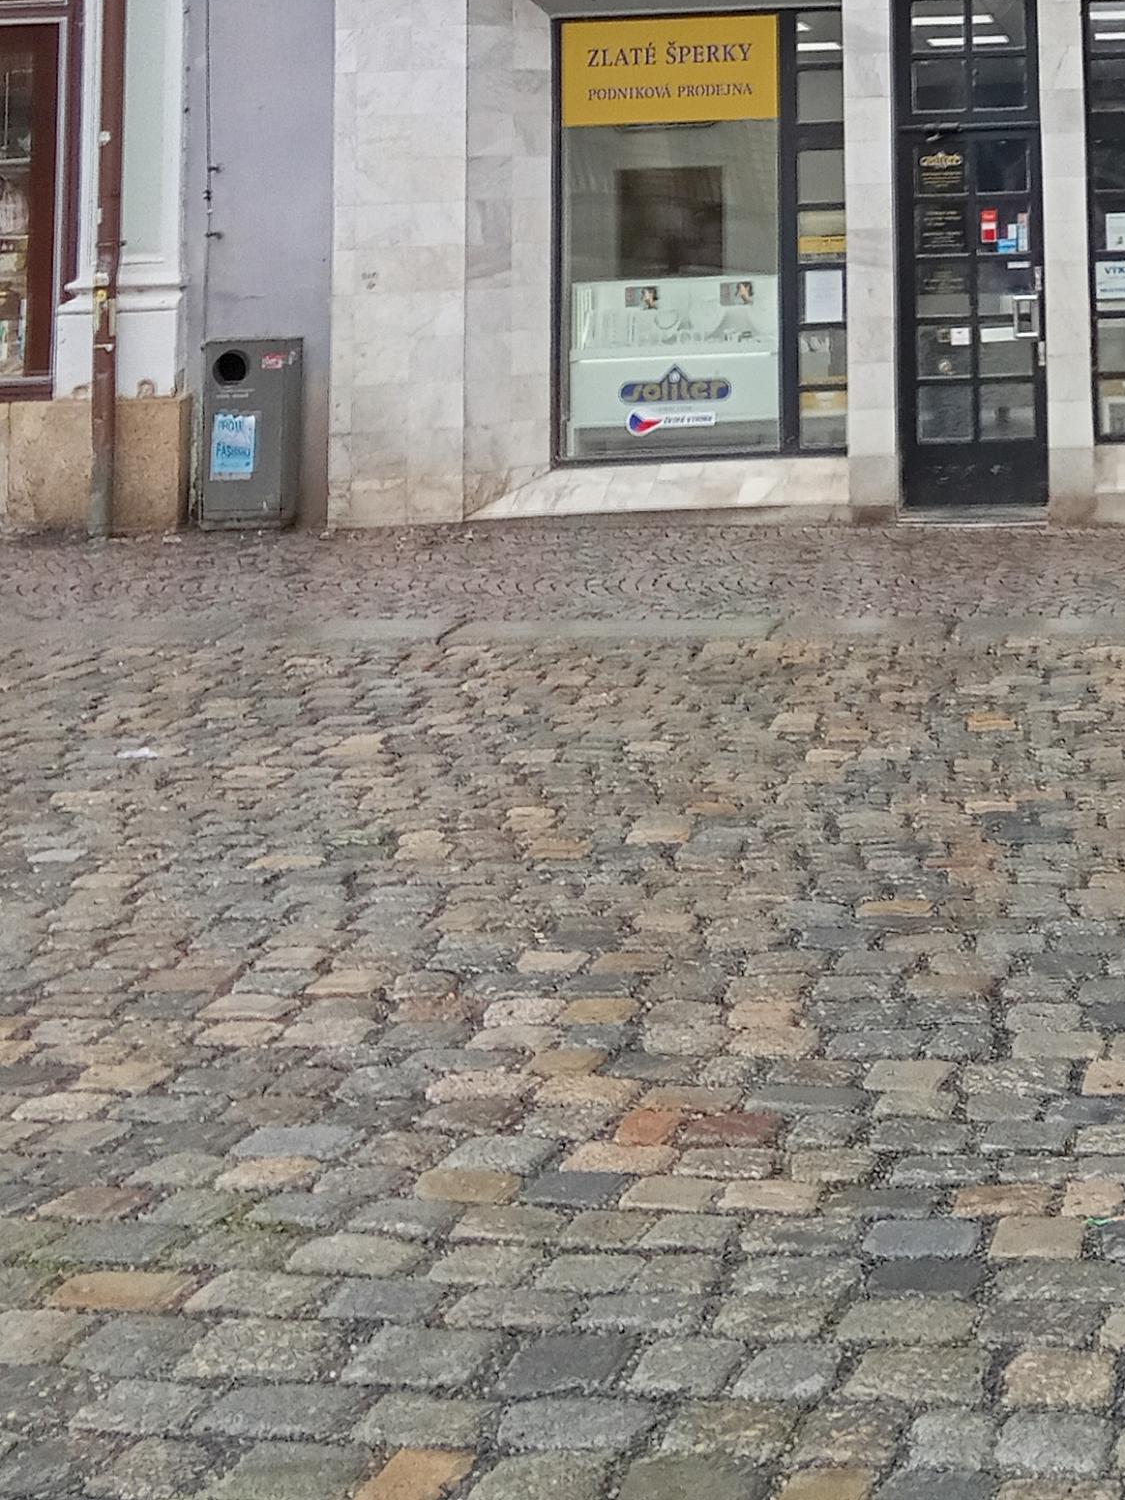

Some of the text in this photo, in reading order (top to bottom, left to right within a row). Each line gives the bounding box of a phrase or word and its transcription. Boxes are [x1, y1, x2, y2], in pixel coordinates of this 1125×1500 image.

[587, 41, 753, 68] ZLATÉ ŠPERKY
[588, 82, 753, 101] PODNIKOVÁ PRODEJNA
[623, 377, 728, 402] soliter
